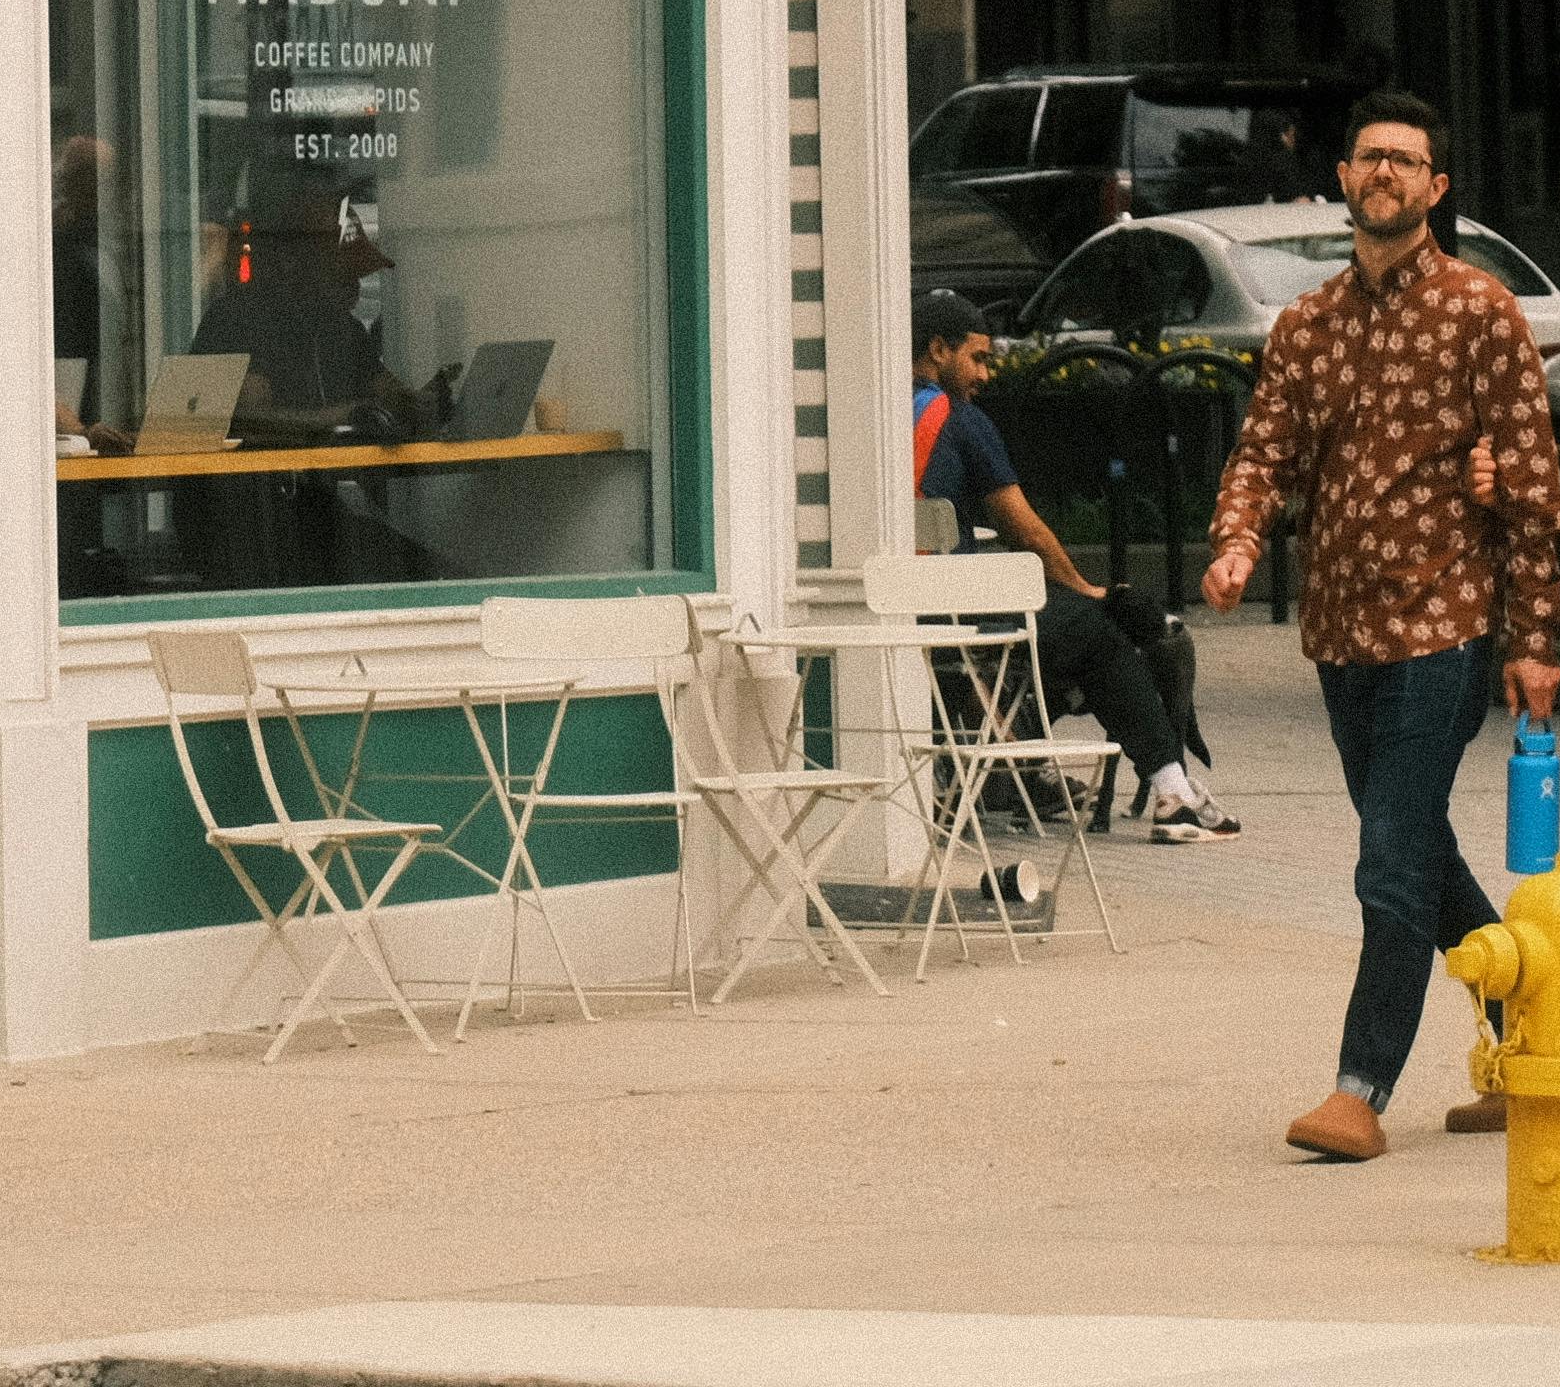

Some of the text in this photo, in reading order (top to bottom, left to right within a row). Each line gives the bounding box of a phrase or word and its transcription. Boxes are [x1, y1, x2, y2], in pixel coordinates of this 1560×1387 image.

[254, 40, 434, 68] COFFEE COMPANY
[269, 87, 421, 113] GRAND RAPIDS
[295, 132, 398, 159] EST. 2008
